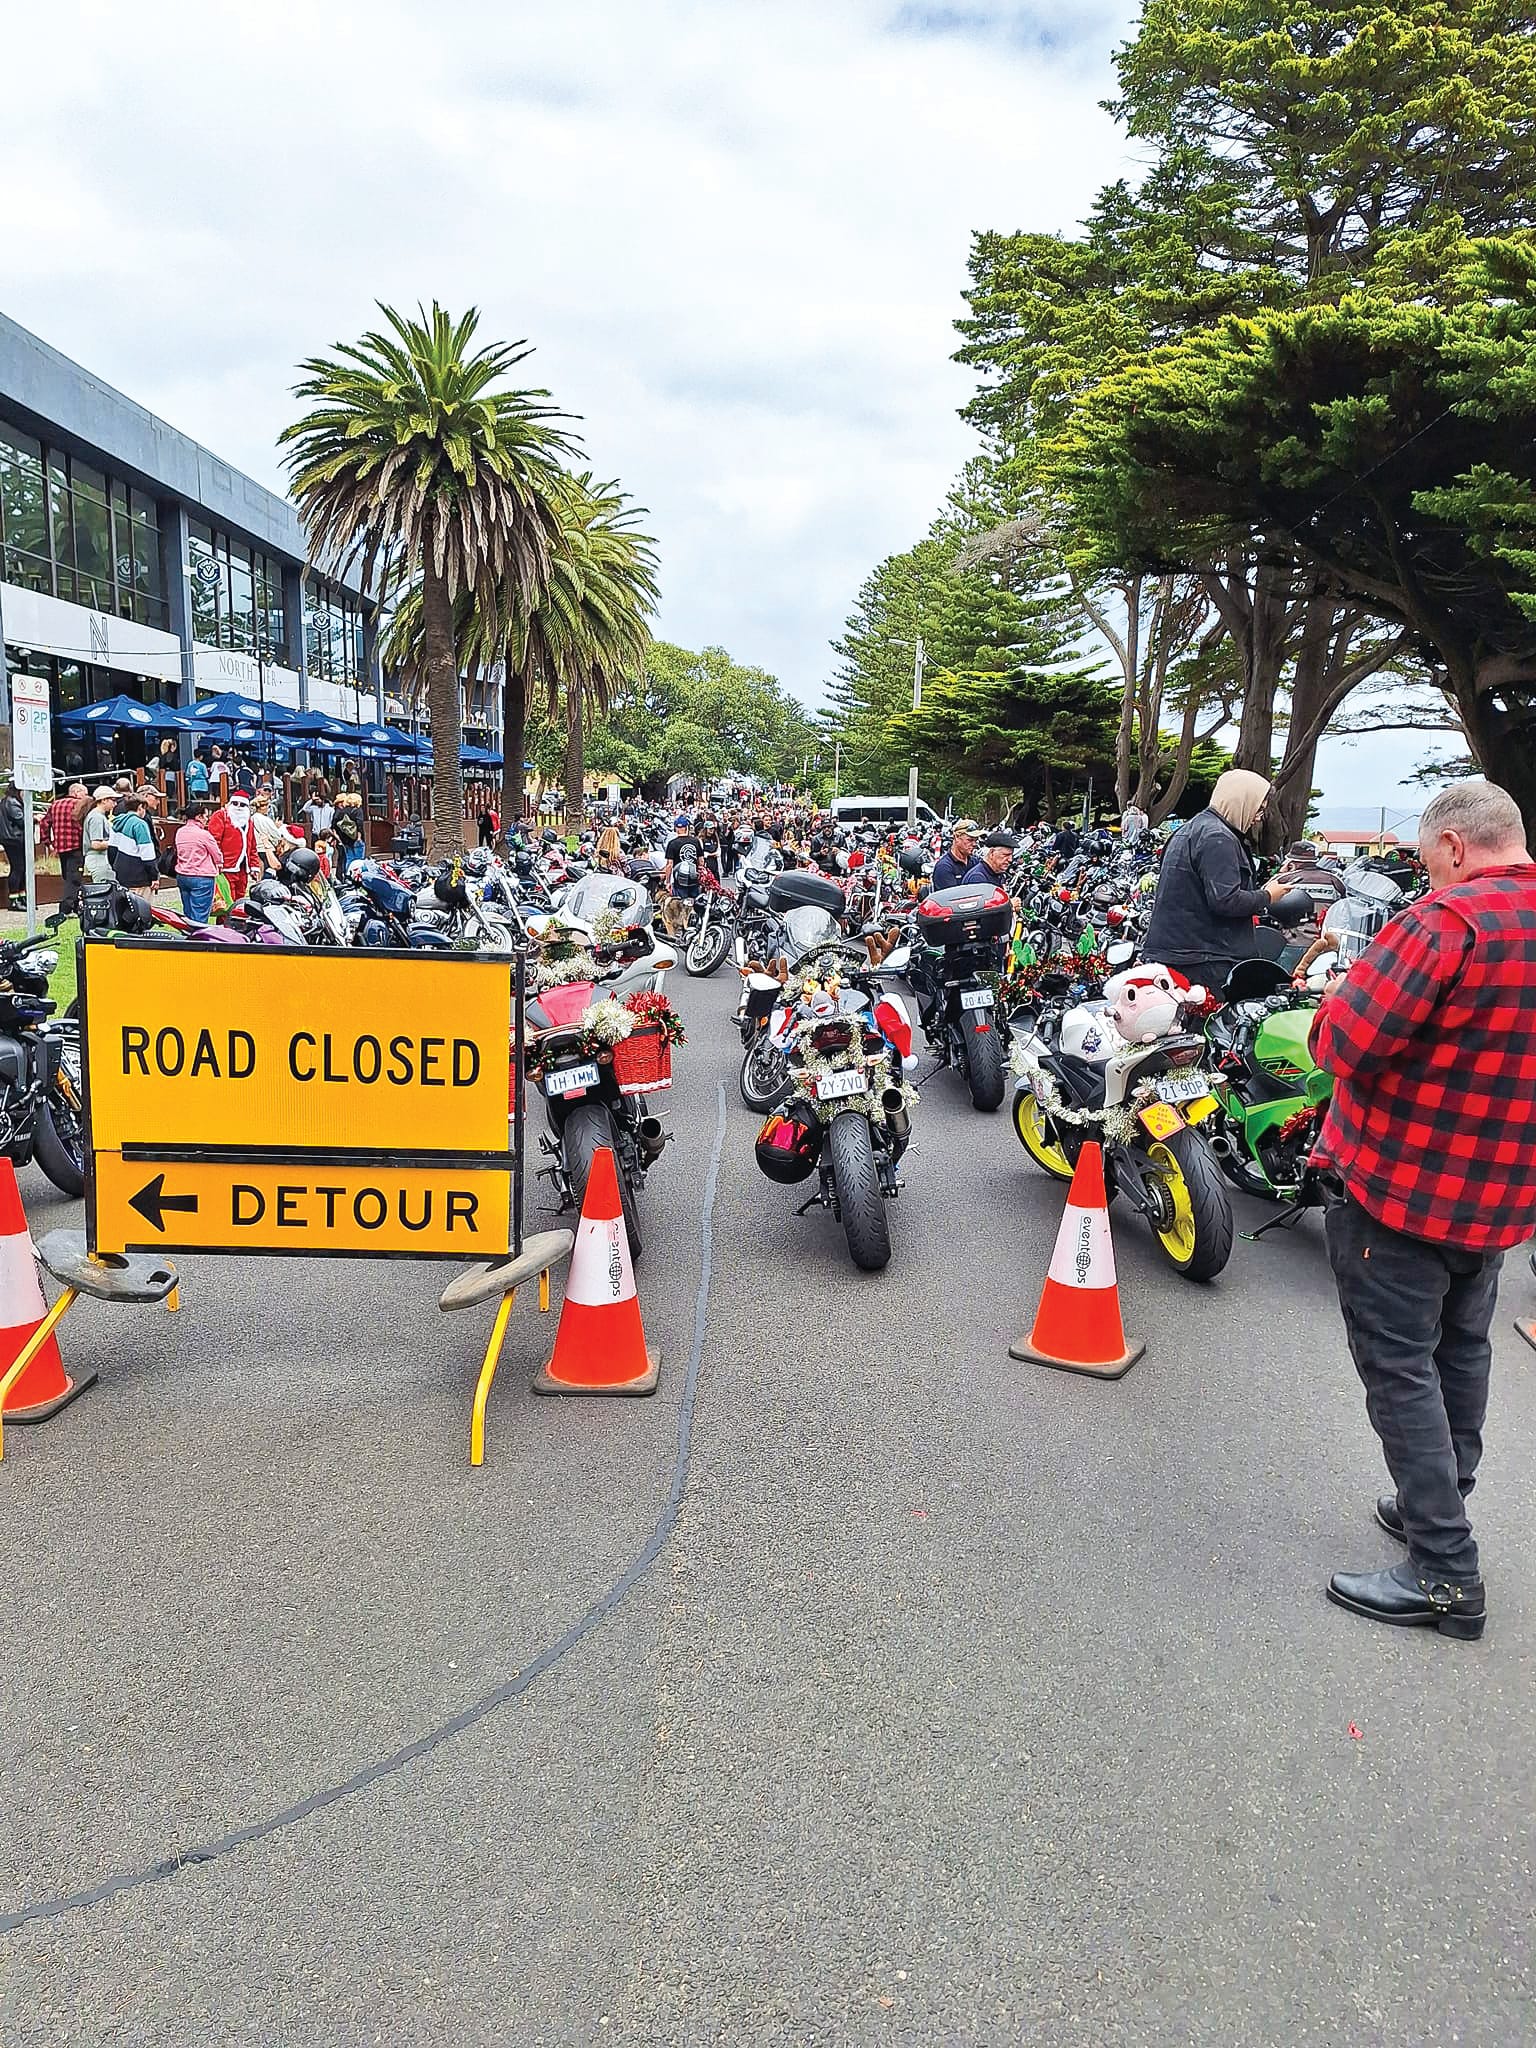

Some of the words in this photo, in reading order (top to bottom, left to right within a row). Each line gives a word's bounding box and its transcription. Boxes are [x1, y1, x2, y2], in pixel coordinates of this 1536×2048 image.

[89, 613, 110, 663] N
[219, 655, 253, 681] NORTH
[33, 711, 48, 724] 2P
[121, 1025, 256, 1079] ROAD
[288, 1031, 481, 1087] CLOSED
[231, 1184, 479, 1233] DETOUR
[609, 1223, 623, 1297] entops
